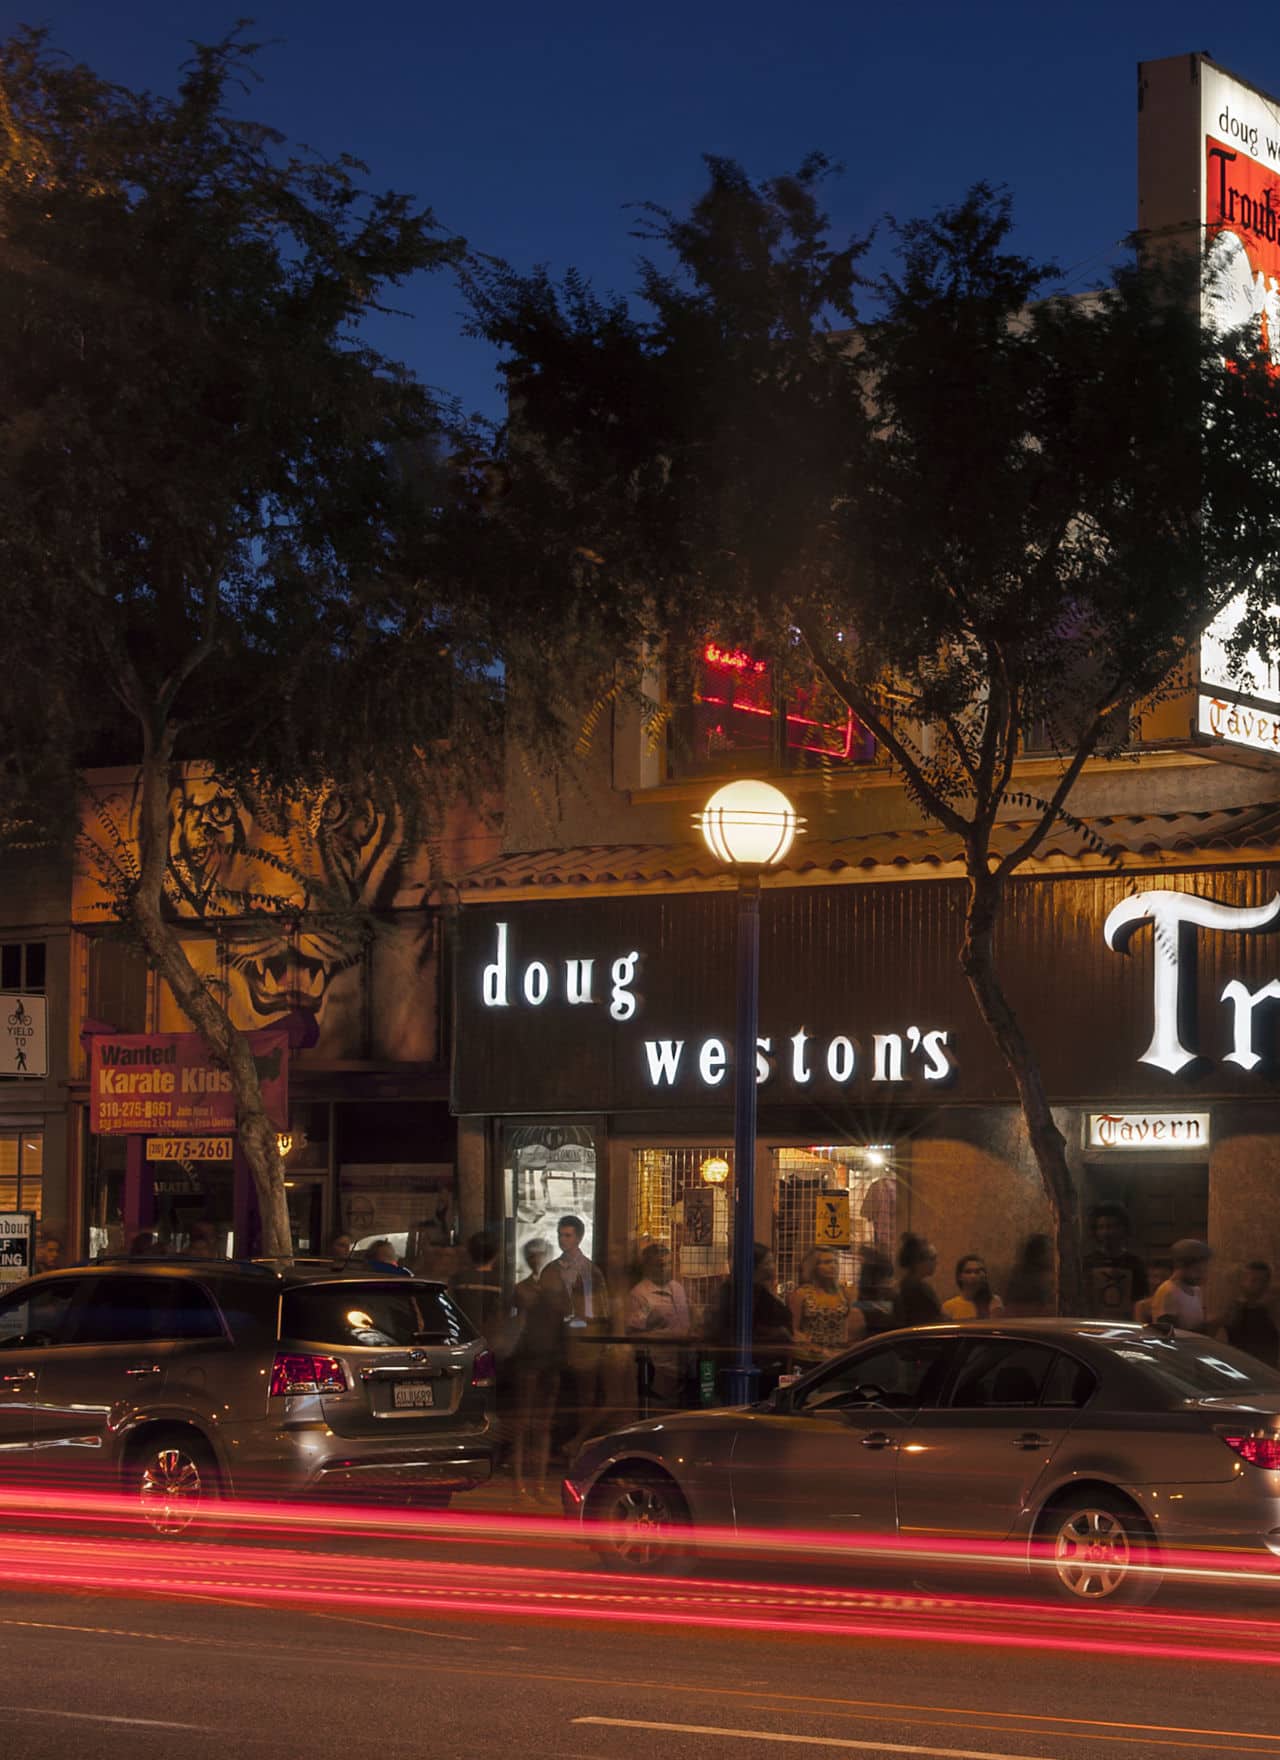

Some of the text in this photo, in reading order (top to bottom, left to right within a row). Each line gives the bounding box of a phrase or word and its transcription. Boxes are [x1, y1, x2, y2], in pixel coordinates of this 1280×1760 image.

[1218, 105, 1259, 157] doug
[481, 921, 640, 1022] doug
[8, 1026, 34, 1037] YIELD
[15, 1037, 27, 1047] TO
[101, 1044, 177, 1066] Wanted
[643, 1025, 951, 1087] weston's
[99, 1067, 233, 1094] Karate Kids
[1096, 1114, 1201, 1147] Tavern
[164, 1141, 230, 1158] 275-2661
